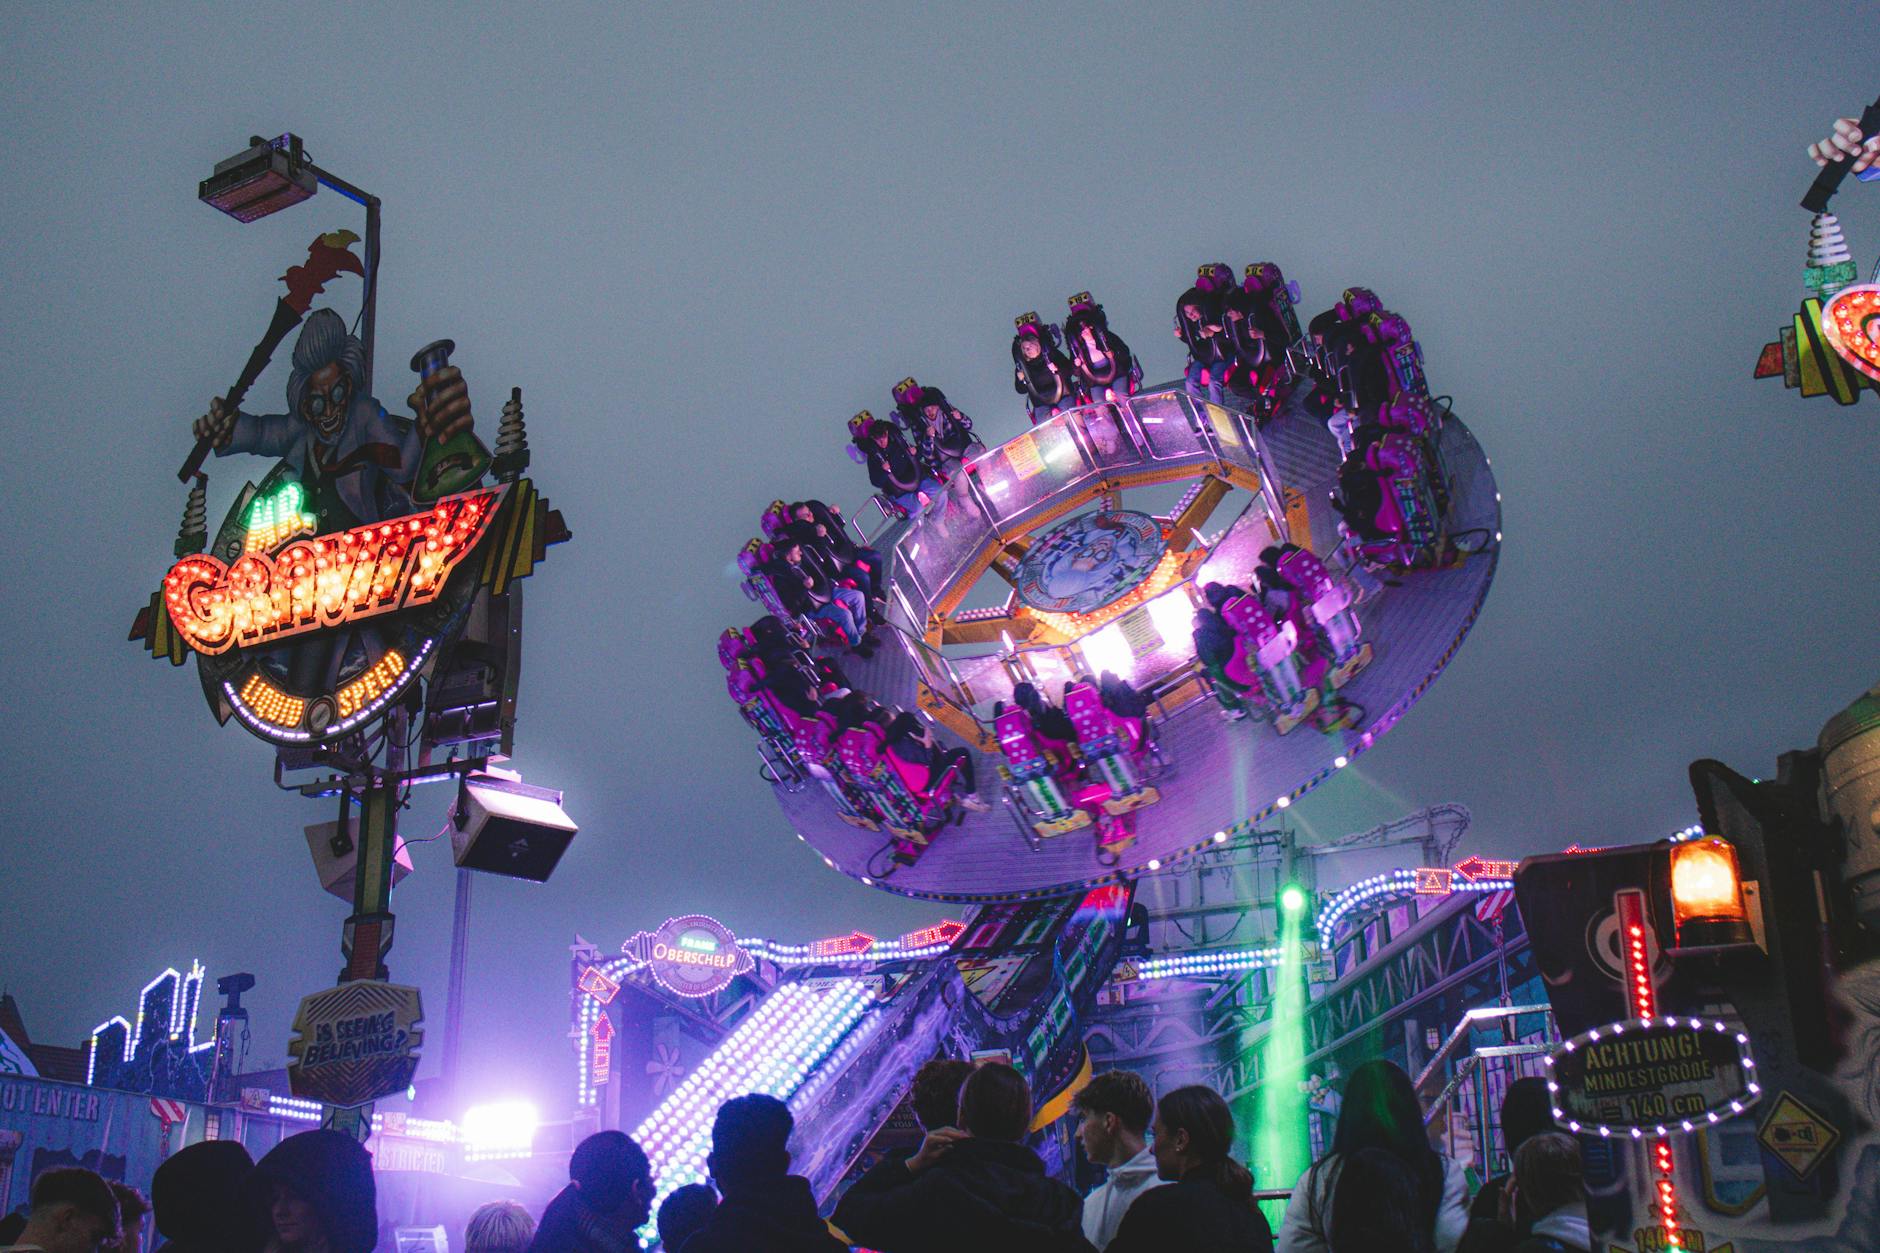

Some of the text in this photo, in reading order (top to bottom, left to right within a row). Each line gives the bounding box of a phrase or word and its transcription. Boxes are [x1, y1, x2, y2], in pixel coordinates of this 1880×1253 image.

[165, 487, 508, 653] GRAVITY
[338, 650, 406, 718] SPEED
[653, 943, 736, 969] OBERSCHELP
[315, 1010, 395, 1042] IS SEEING
[303, 1029, 408, 1066] BELIEVING?
[1586, 1033, 1701, 1070] ACHTUNG!
[0, 1083, 31, 1111] OT
[1629, 1095, 1666, 1119] 140
[1673, 1095, 1705, 1114] cm
[377, 1149, 446, 1173] STRICTED
